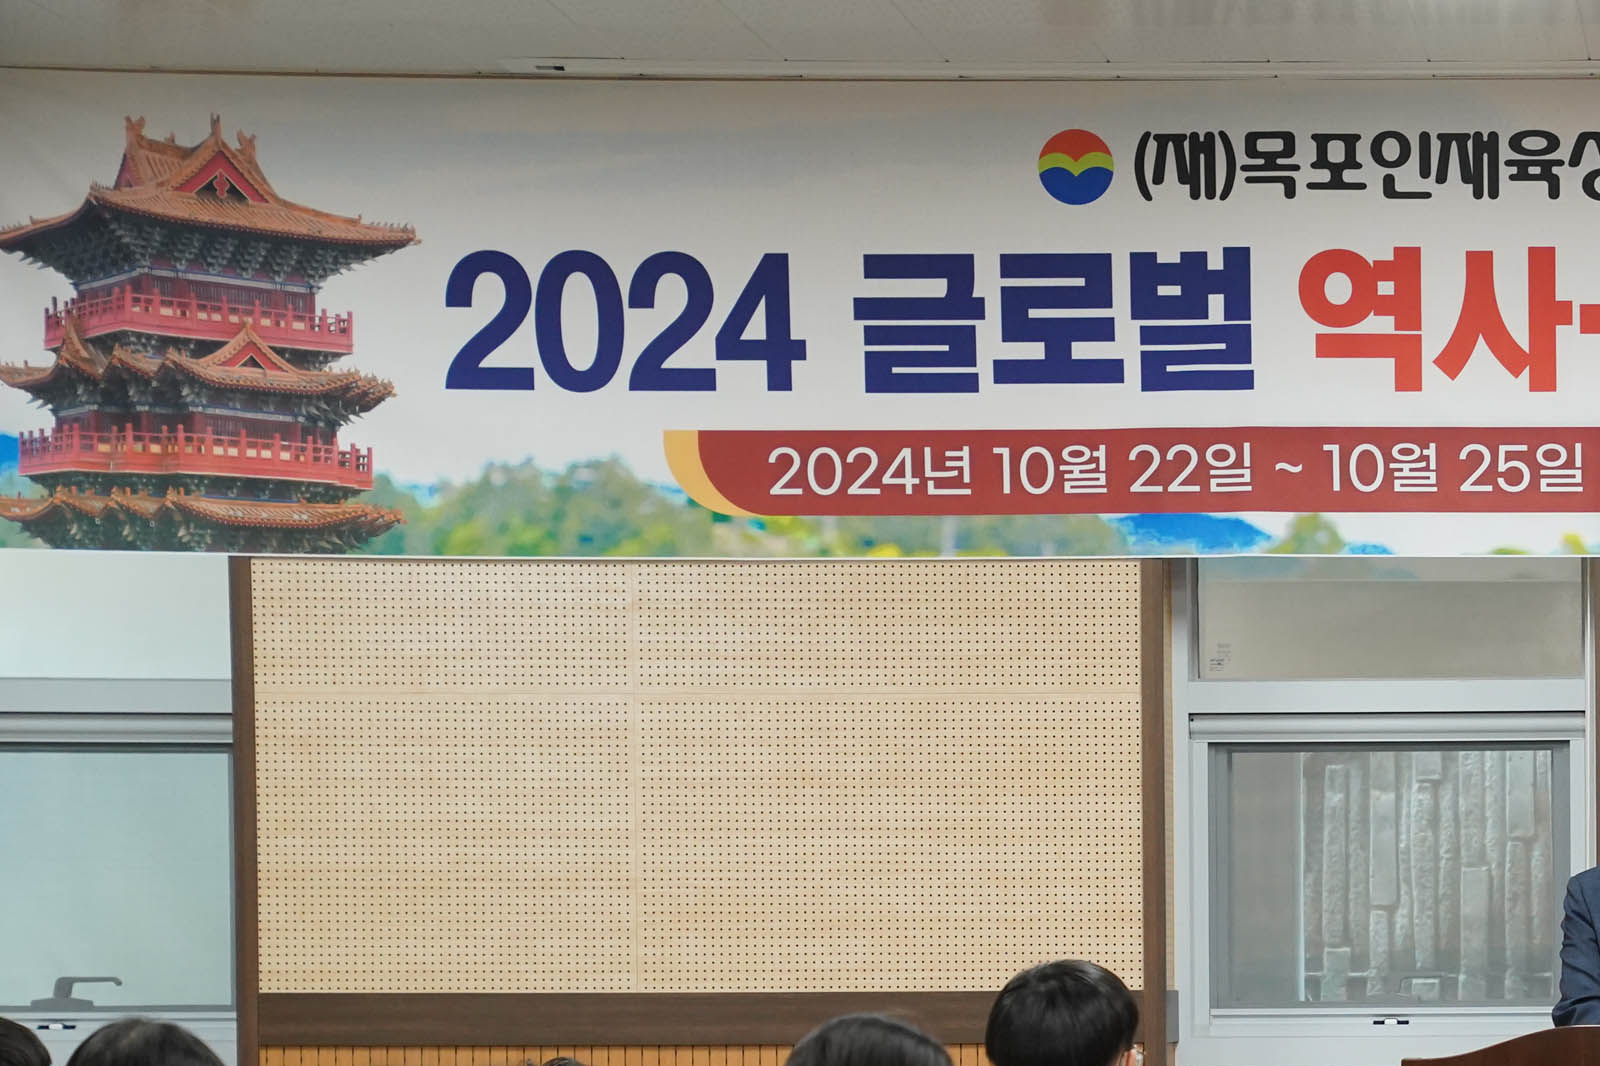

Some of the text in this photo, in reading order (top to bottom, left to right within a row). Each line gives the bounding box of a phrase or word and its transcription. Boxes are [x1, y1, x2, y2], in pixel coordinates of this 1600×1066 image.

[445, 249, 807, 393] 2024
[853, 245, 1255, 393] 글로벌
[768, 444, 972, 496] 2024년
[992, 443, 1108, 496] 10월
[1128, 442, 1253, 494] 22일
[1274, 460, 1303, 475] ~
[1322, 442, 1438, 494] 10월
[1458, 442, 1584, 494] 25일
